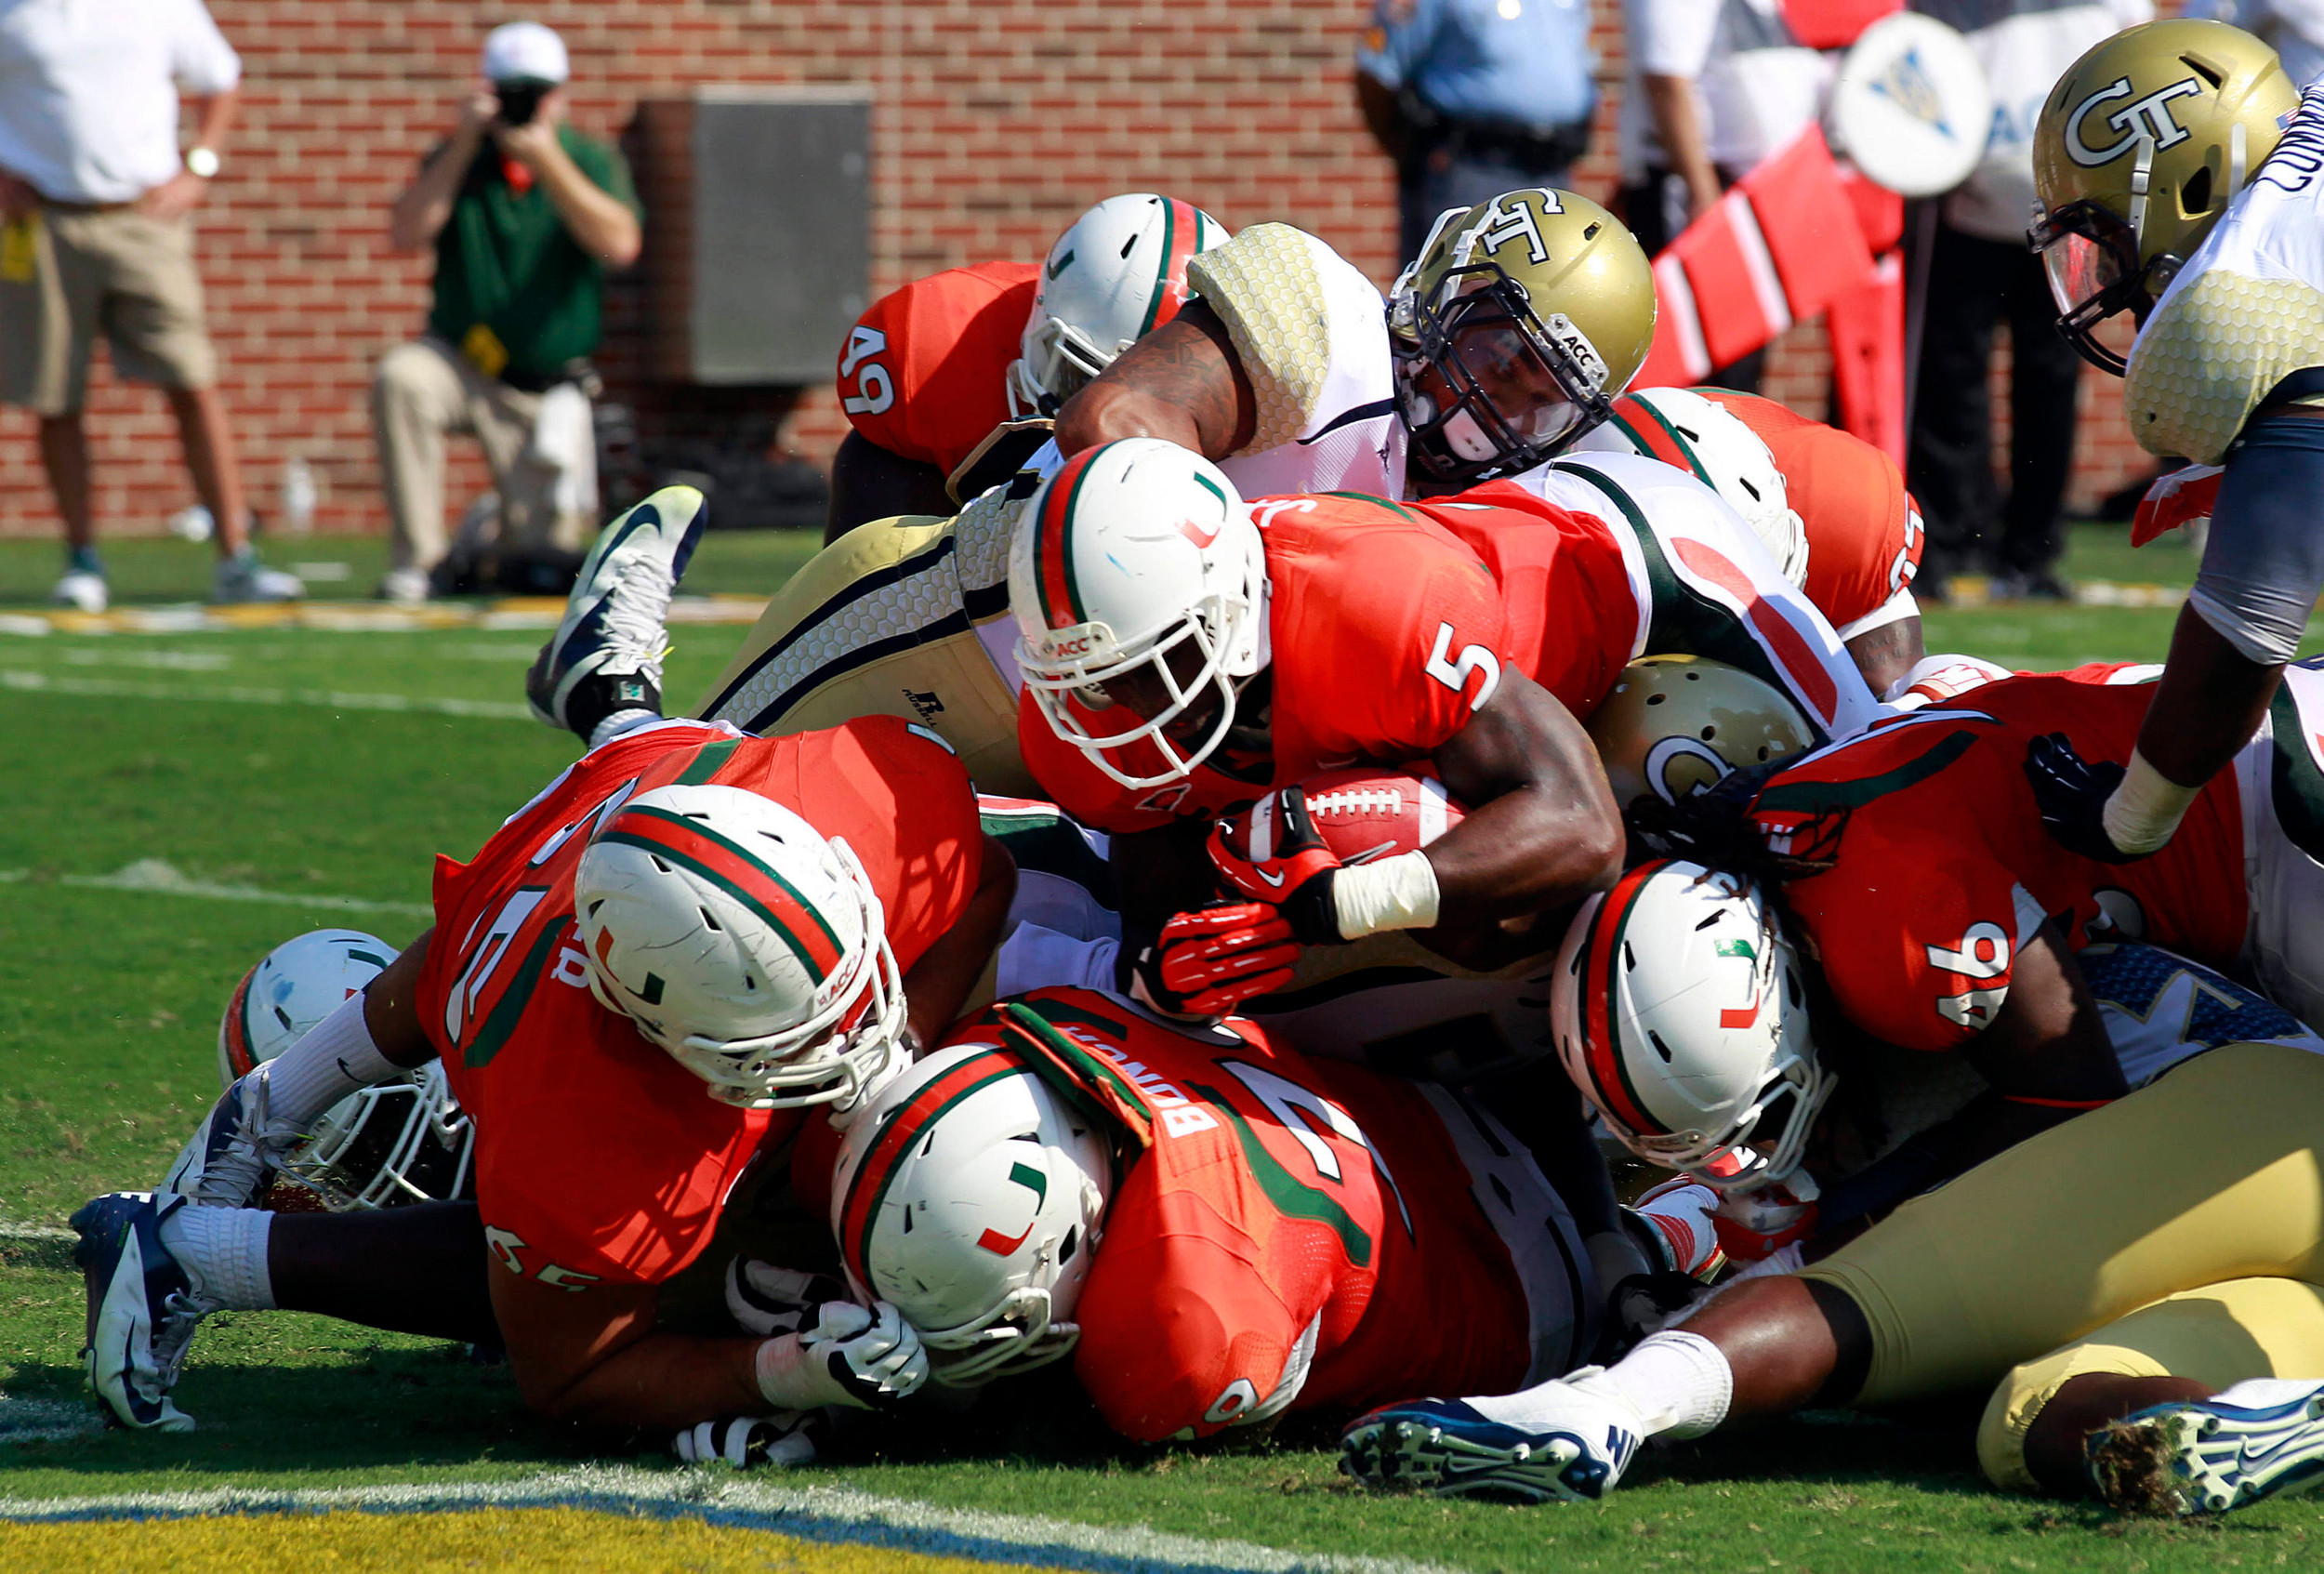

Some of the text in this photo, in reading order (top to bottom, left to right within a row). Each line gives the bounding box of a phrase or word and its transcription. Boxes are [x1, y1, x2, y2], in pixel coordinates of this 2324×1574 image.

[2064, 75, 2202, 168] GT
[840, 325, 894, 416] 49
[1563, 337, 1595, 366] ACC
[1057, 636, 1090, 657] ACC
[1424, 620, 1502, 714] 5
[828, 958, 854, 1001] ACC
[1925, 920, 2011, 1031] 46
